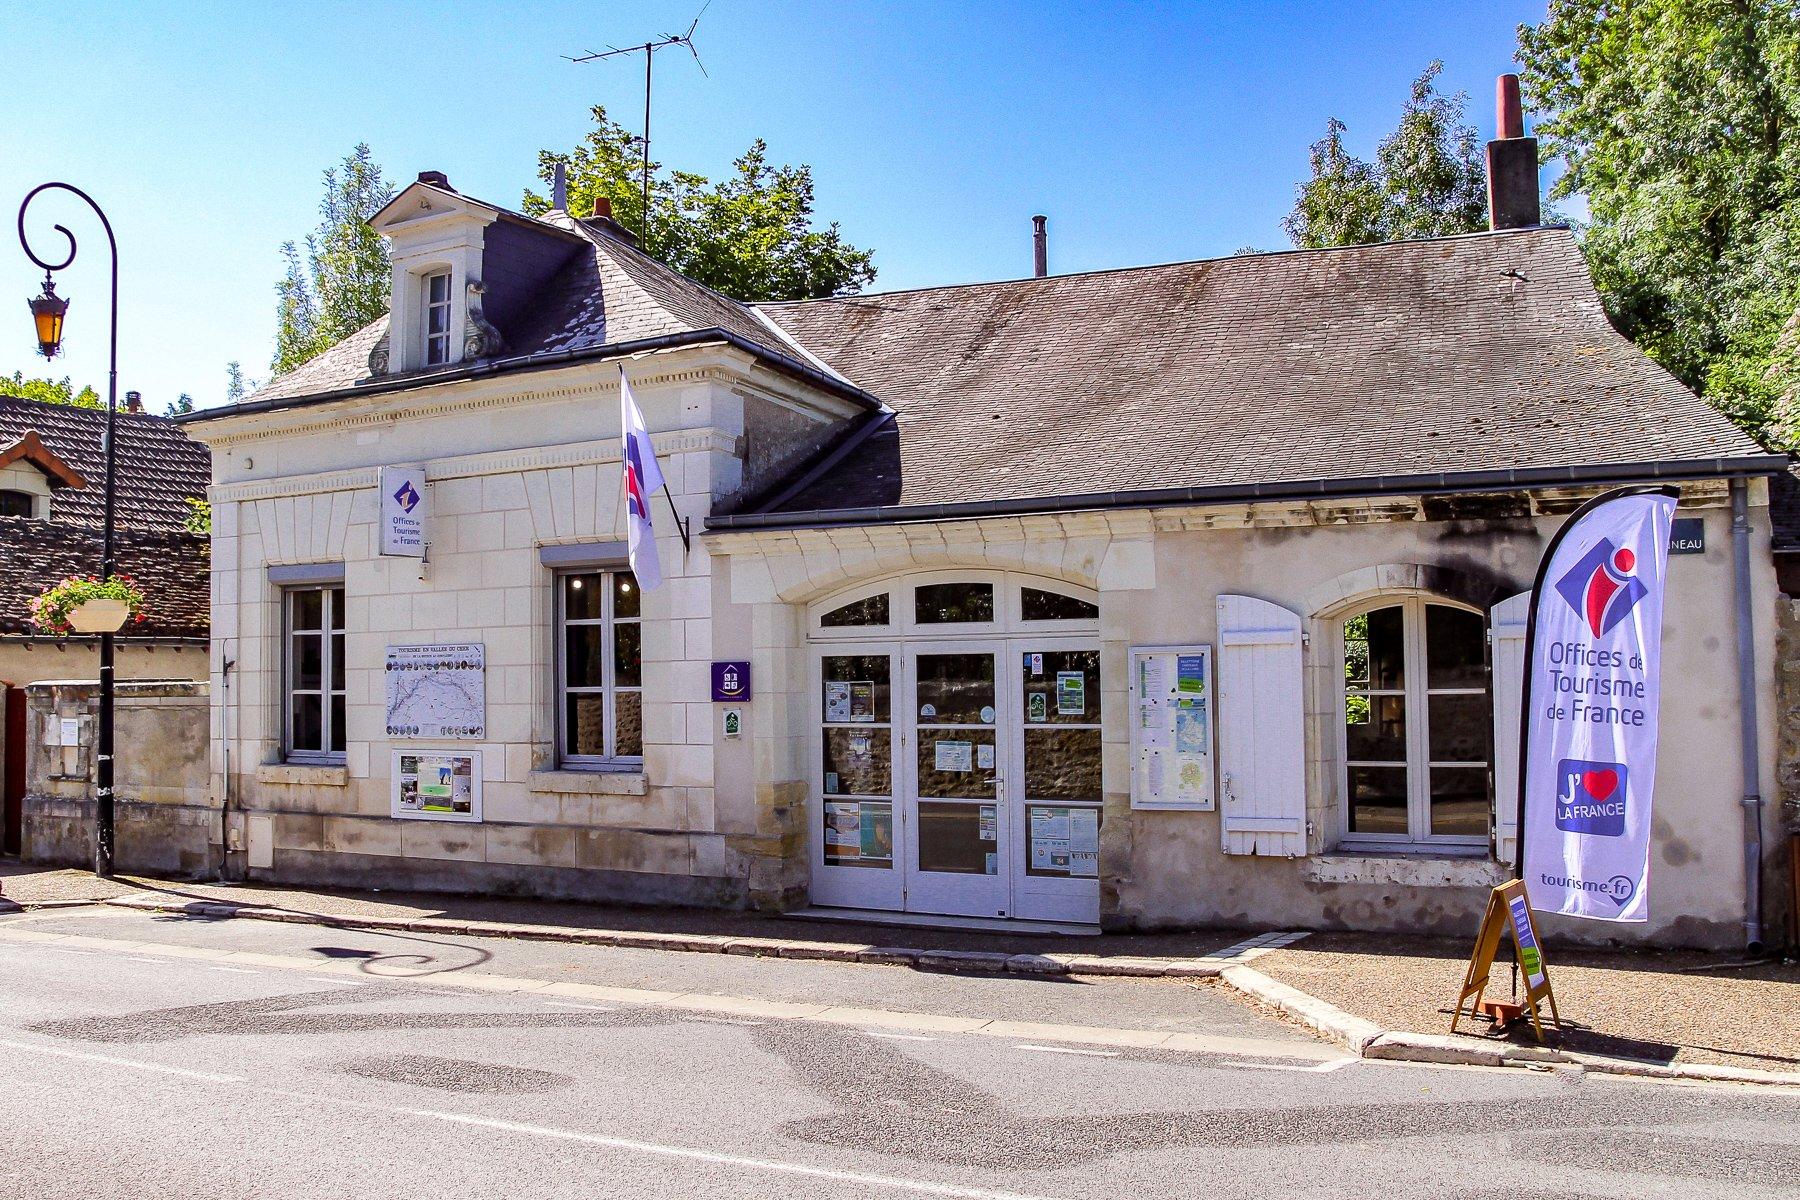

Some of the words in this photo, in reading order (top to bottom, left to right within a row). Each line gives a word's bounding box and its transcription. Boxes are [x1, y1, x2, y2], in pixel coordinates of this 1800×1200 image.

[393, 517, 415, 526] Offices
[393, 527, 421, 536] Tourisme
[400, 537, 421, 545] France
[1550, 641, 1622, 668] Offices
[1629, 652, 1643, 671] de
[1549, 669, 1645, 698] Tourisme
[1546, 702, 1565, 720] de
[1572, 699, 1644, 726] France
[1558, 773, 1581, 805] J'
[1557, 807, 1573, 820] LA
[1574, 802, 1625, 819] FRANCE
[1540, 873, 1628, 895] tourisme.fr
